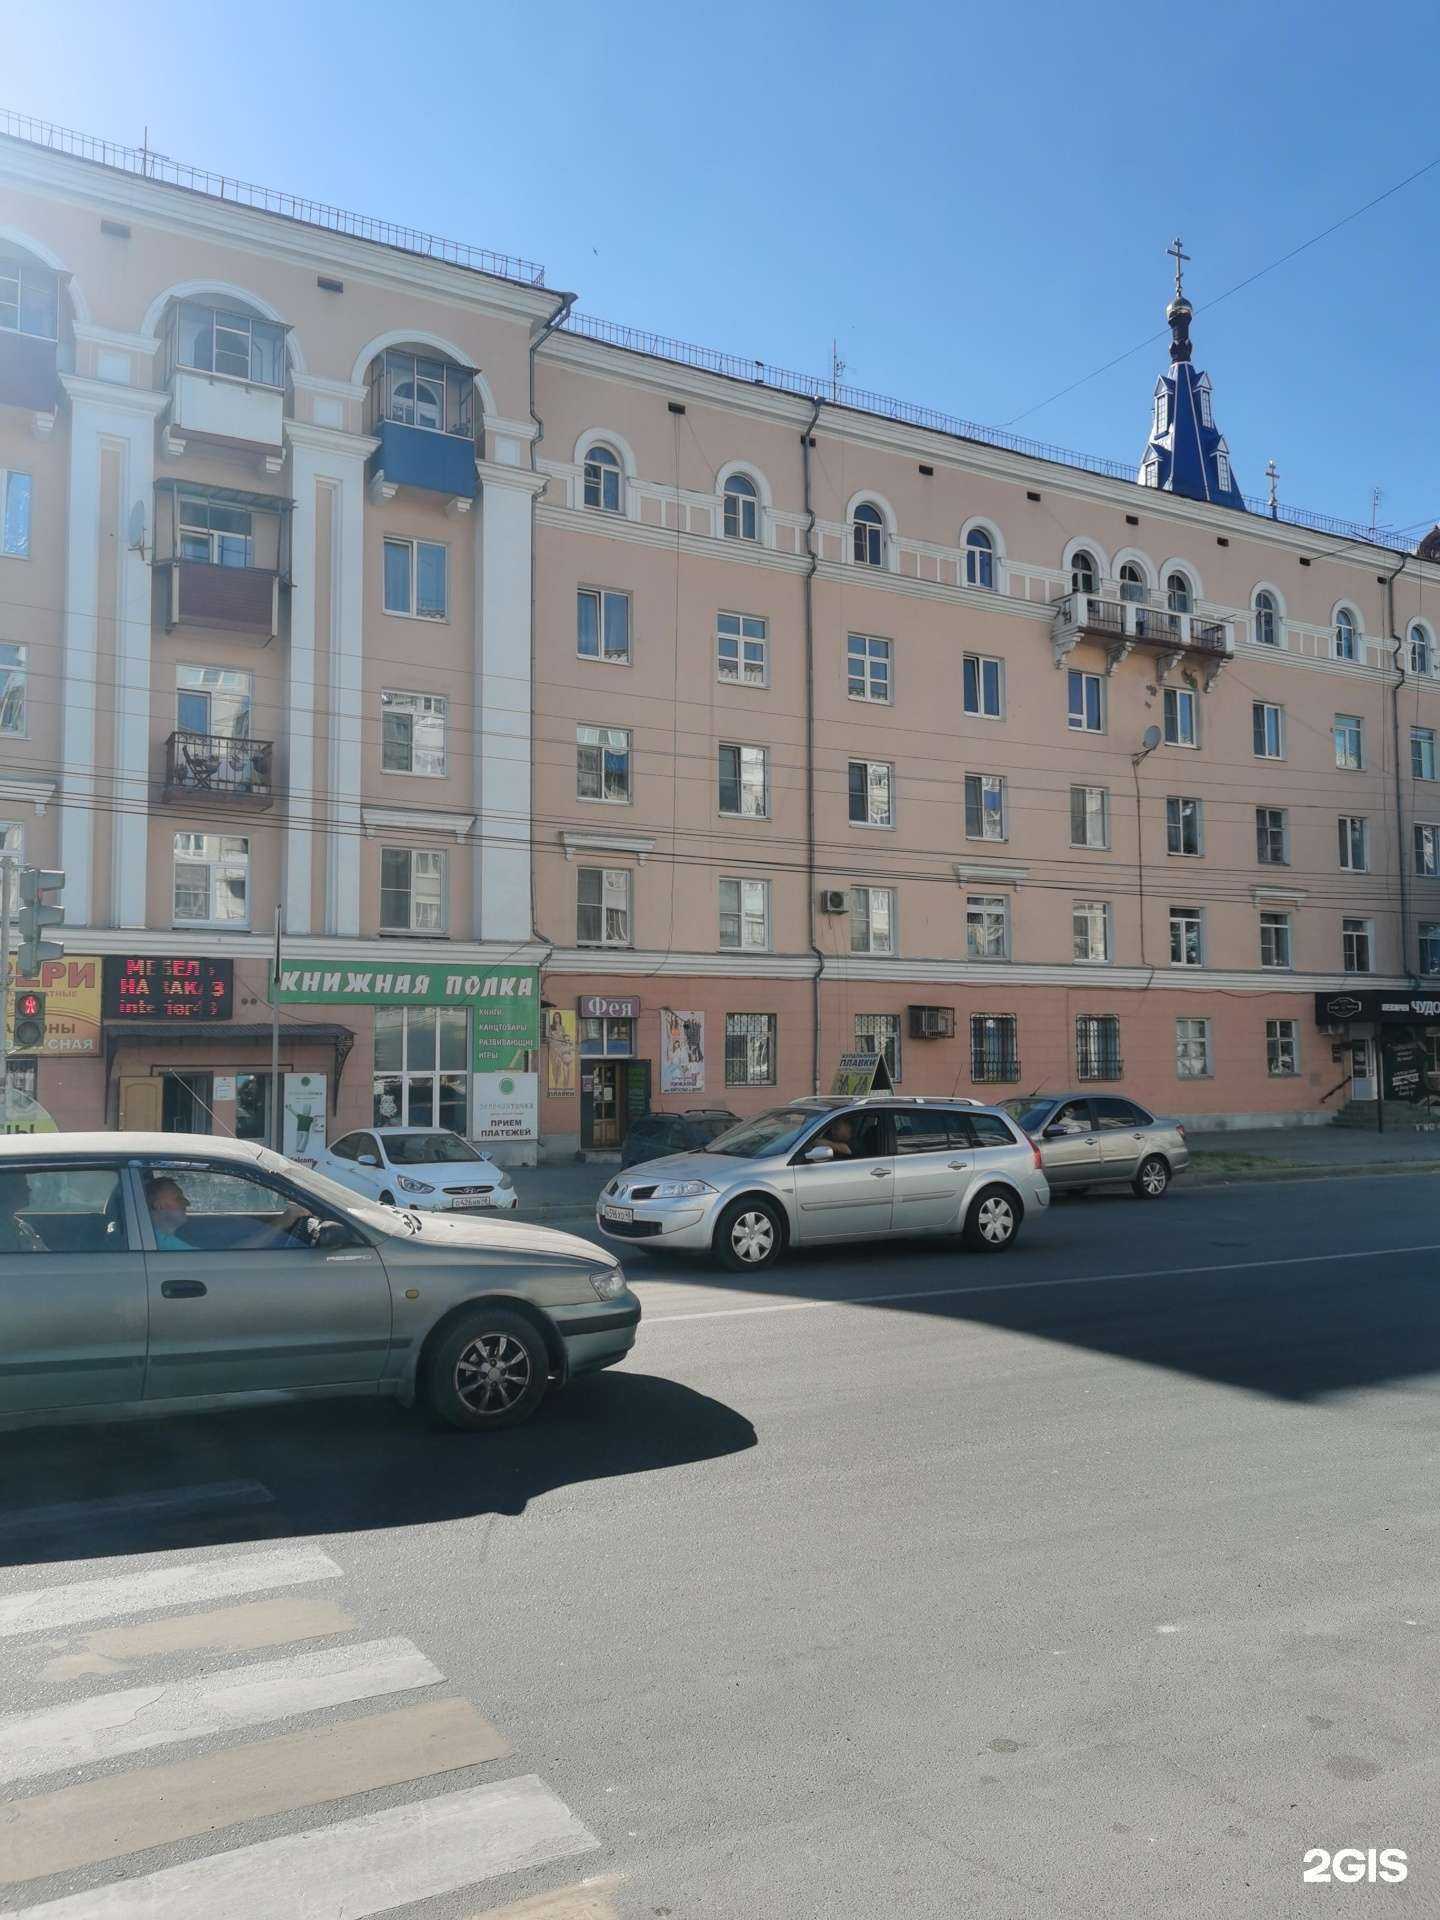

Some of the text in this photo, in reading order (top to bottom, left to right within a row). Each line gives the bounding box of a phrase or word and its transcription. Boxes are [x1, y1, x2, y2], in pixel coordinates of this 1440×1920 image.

[280, 971, 532, 996] КНИЖНАЯ ПОЛКА
[588, 997, 633, 1016] Фея
[479, 1024, 528, 1032] КАНЦТОВАРЫ
[839, 1059, 877, 1067] ПЛАВКИ
[490, 1119, 522, 1127] ПРИЕМ
[480, 1128, 532, 1137] ПЛАТЕЖЕЙ
